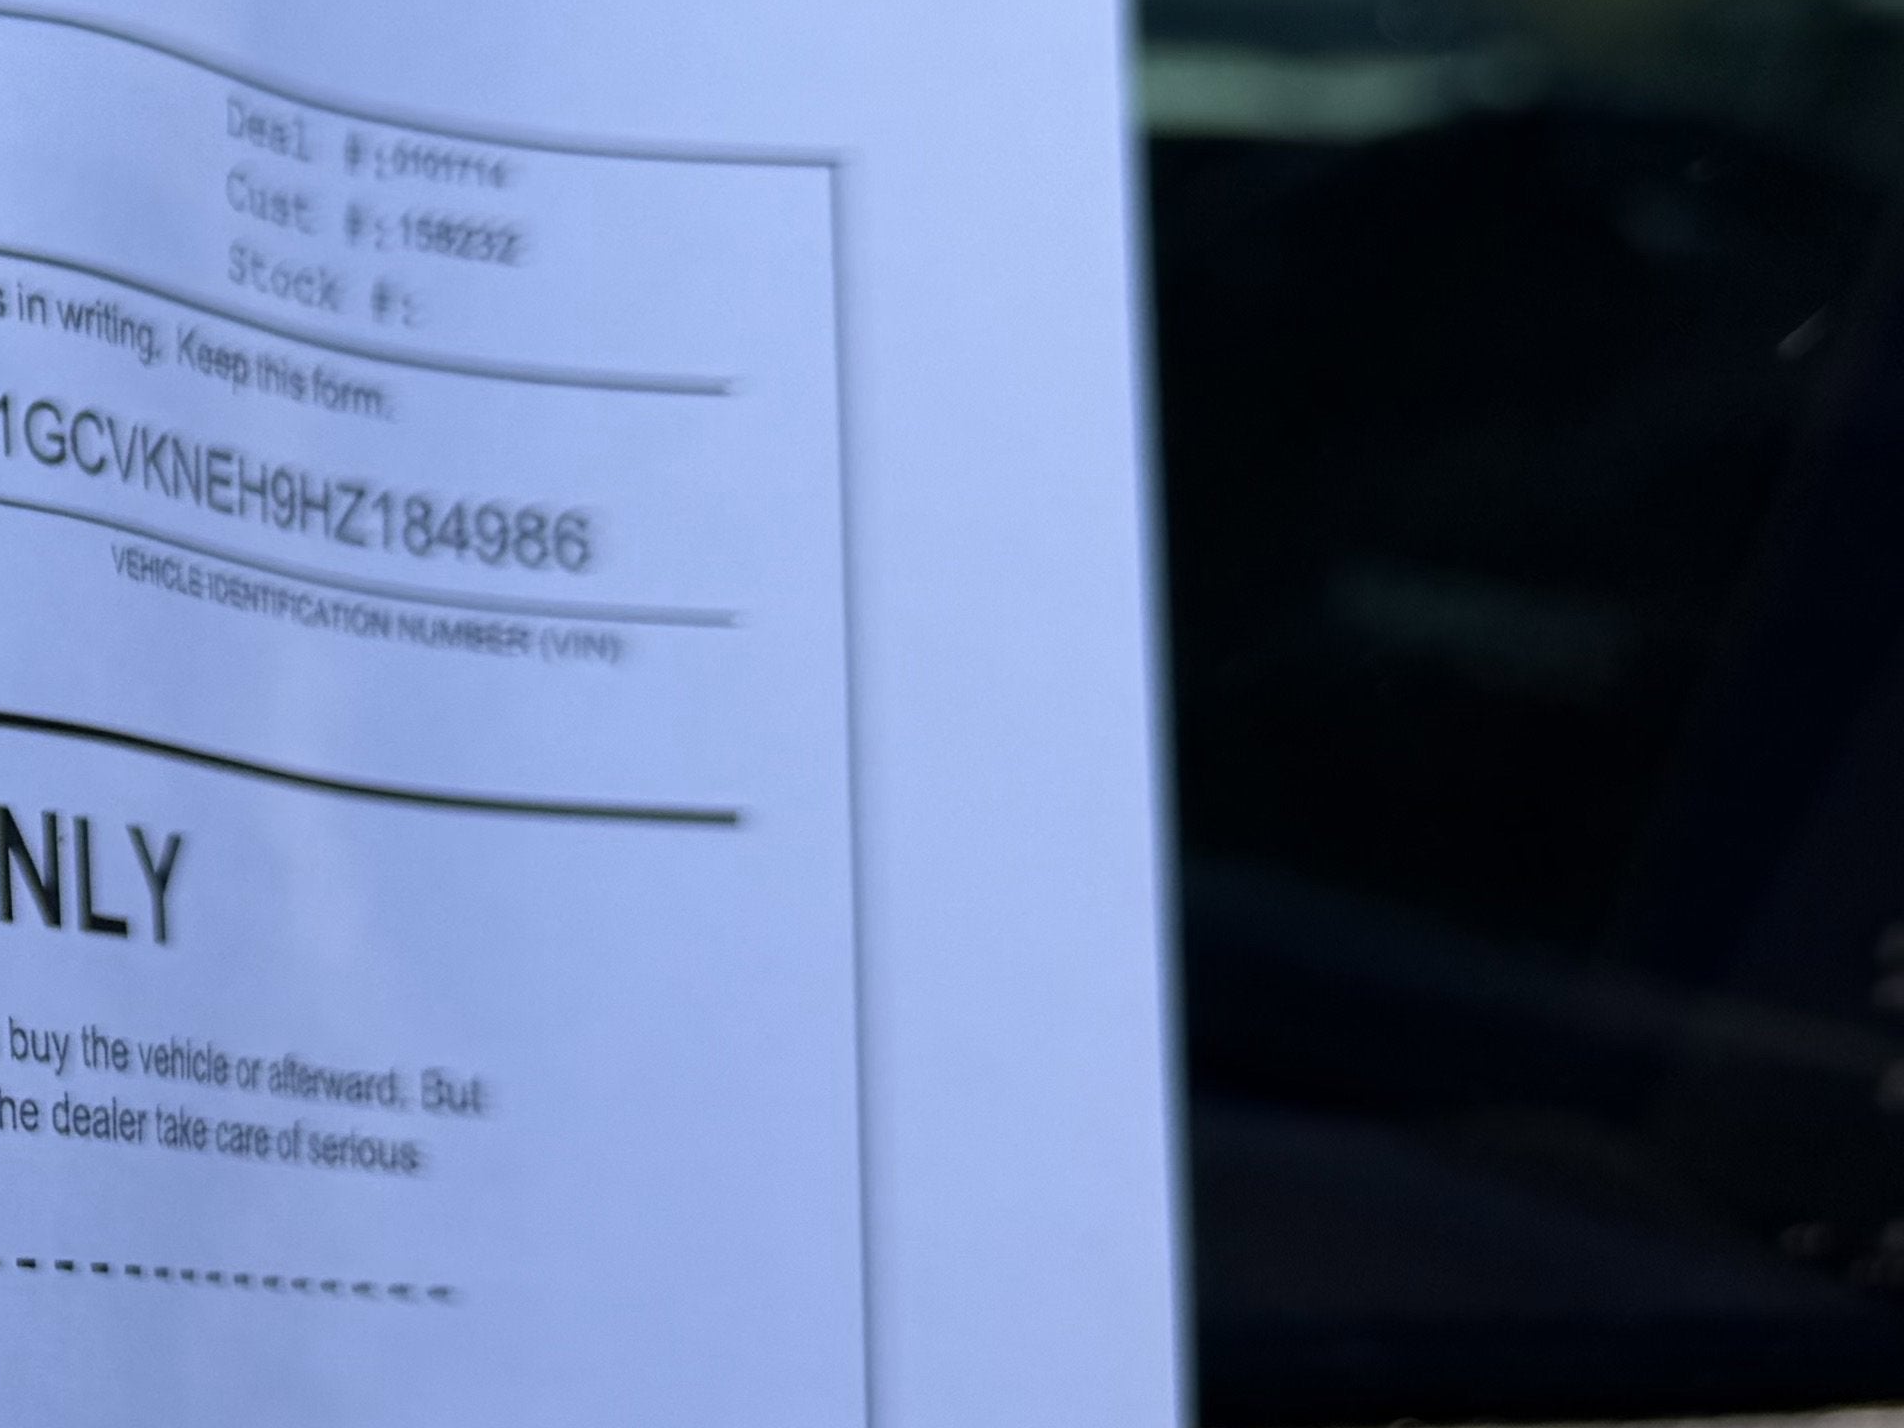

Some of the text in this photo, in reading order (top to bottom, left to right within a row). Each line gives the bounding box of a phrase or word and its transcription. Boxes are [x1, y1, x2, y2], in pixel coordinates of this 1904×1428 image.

[18, 292, 48, 325] in
[56, 299, 163, 367] writing.
[175, 326, 249, 385] Keep
[254, 346, 304, 397] this
[111, 544, 206, 602] VEHICLE
[208, 573, 392, 639] IDENTIFICATION
[396, 613, 531, 656] NUMBER
[9, 1016, 71, 1077] buy
[81, 1025, 132, 1073] the
[52, 1091, 148, 1144] dealer
